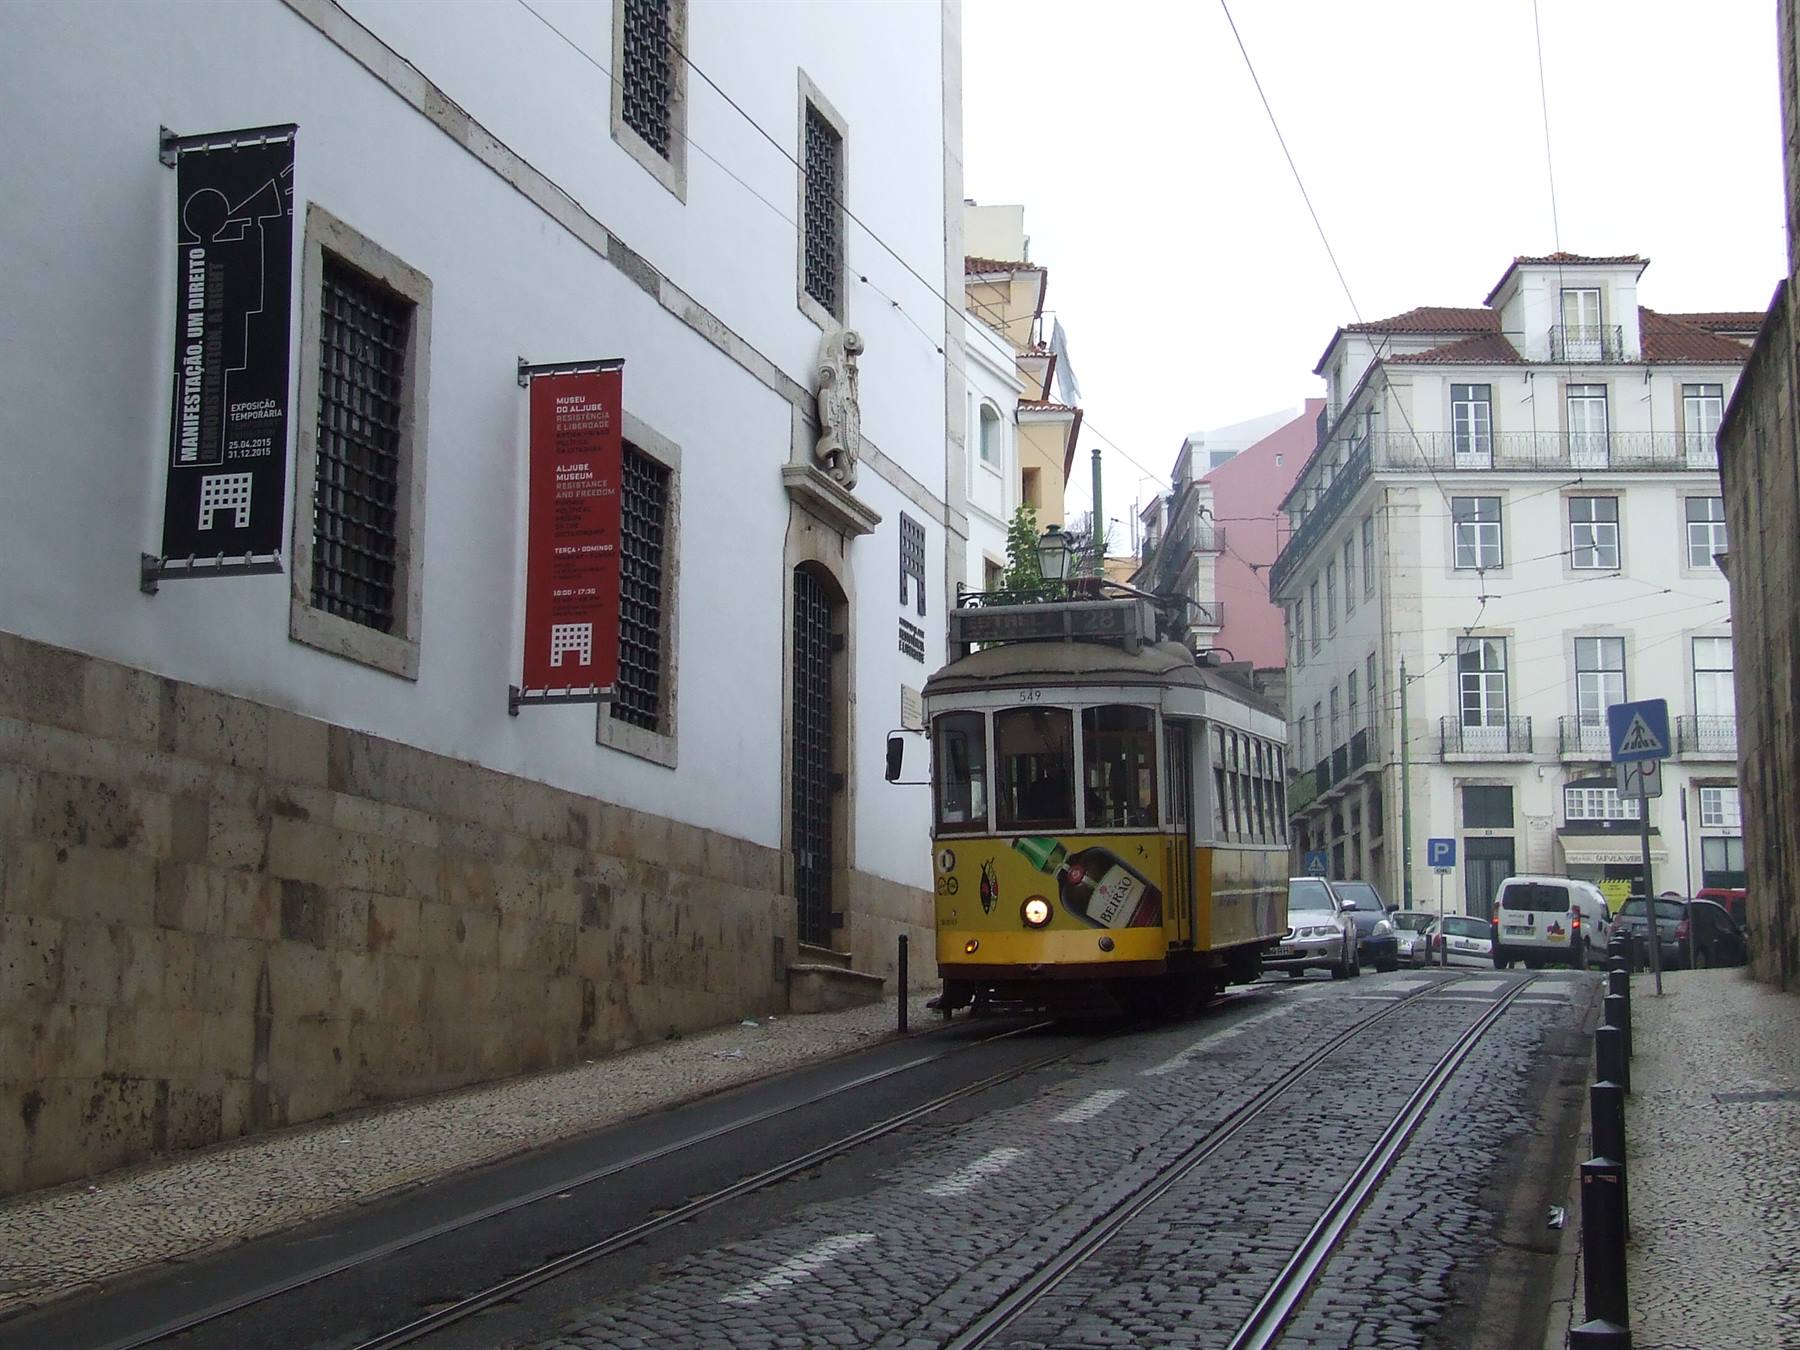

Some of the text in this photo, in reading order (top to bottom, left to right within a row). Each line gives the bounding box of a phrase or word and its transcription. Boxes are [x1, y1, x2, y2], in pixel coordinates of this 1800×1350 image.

[188, 248, 206, 310] DIREITO
[187, 312, 204, 338] UM
[556, 396, 586, 405] MUSEU
[570, 403, 602, 412] ALJUBE
[231, 409, 282, 421] TEMPORÁRIA
[228, 438, 271, 449] 25.04.2015
[228, 447, 271, 458] 31.12.2015
[556, 463, 589, 472] ALJUBE
[556, 472, 593, 480] MUSEUM
[556, 480, 608, 490] RESISTANCE
[575, 488, 616, 497] FREEDOM
[581, 544, 613, 552] DOMINGO
[1083, 609, 1116, 630] 28
[1020, 690, 1041, 702] 549
[1434, 843, 1449, 863] P
